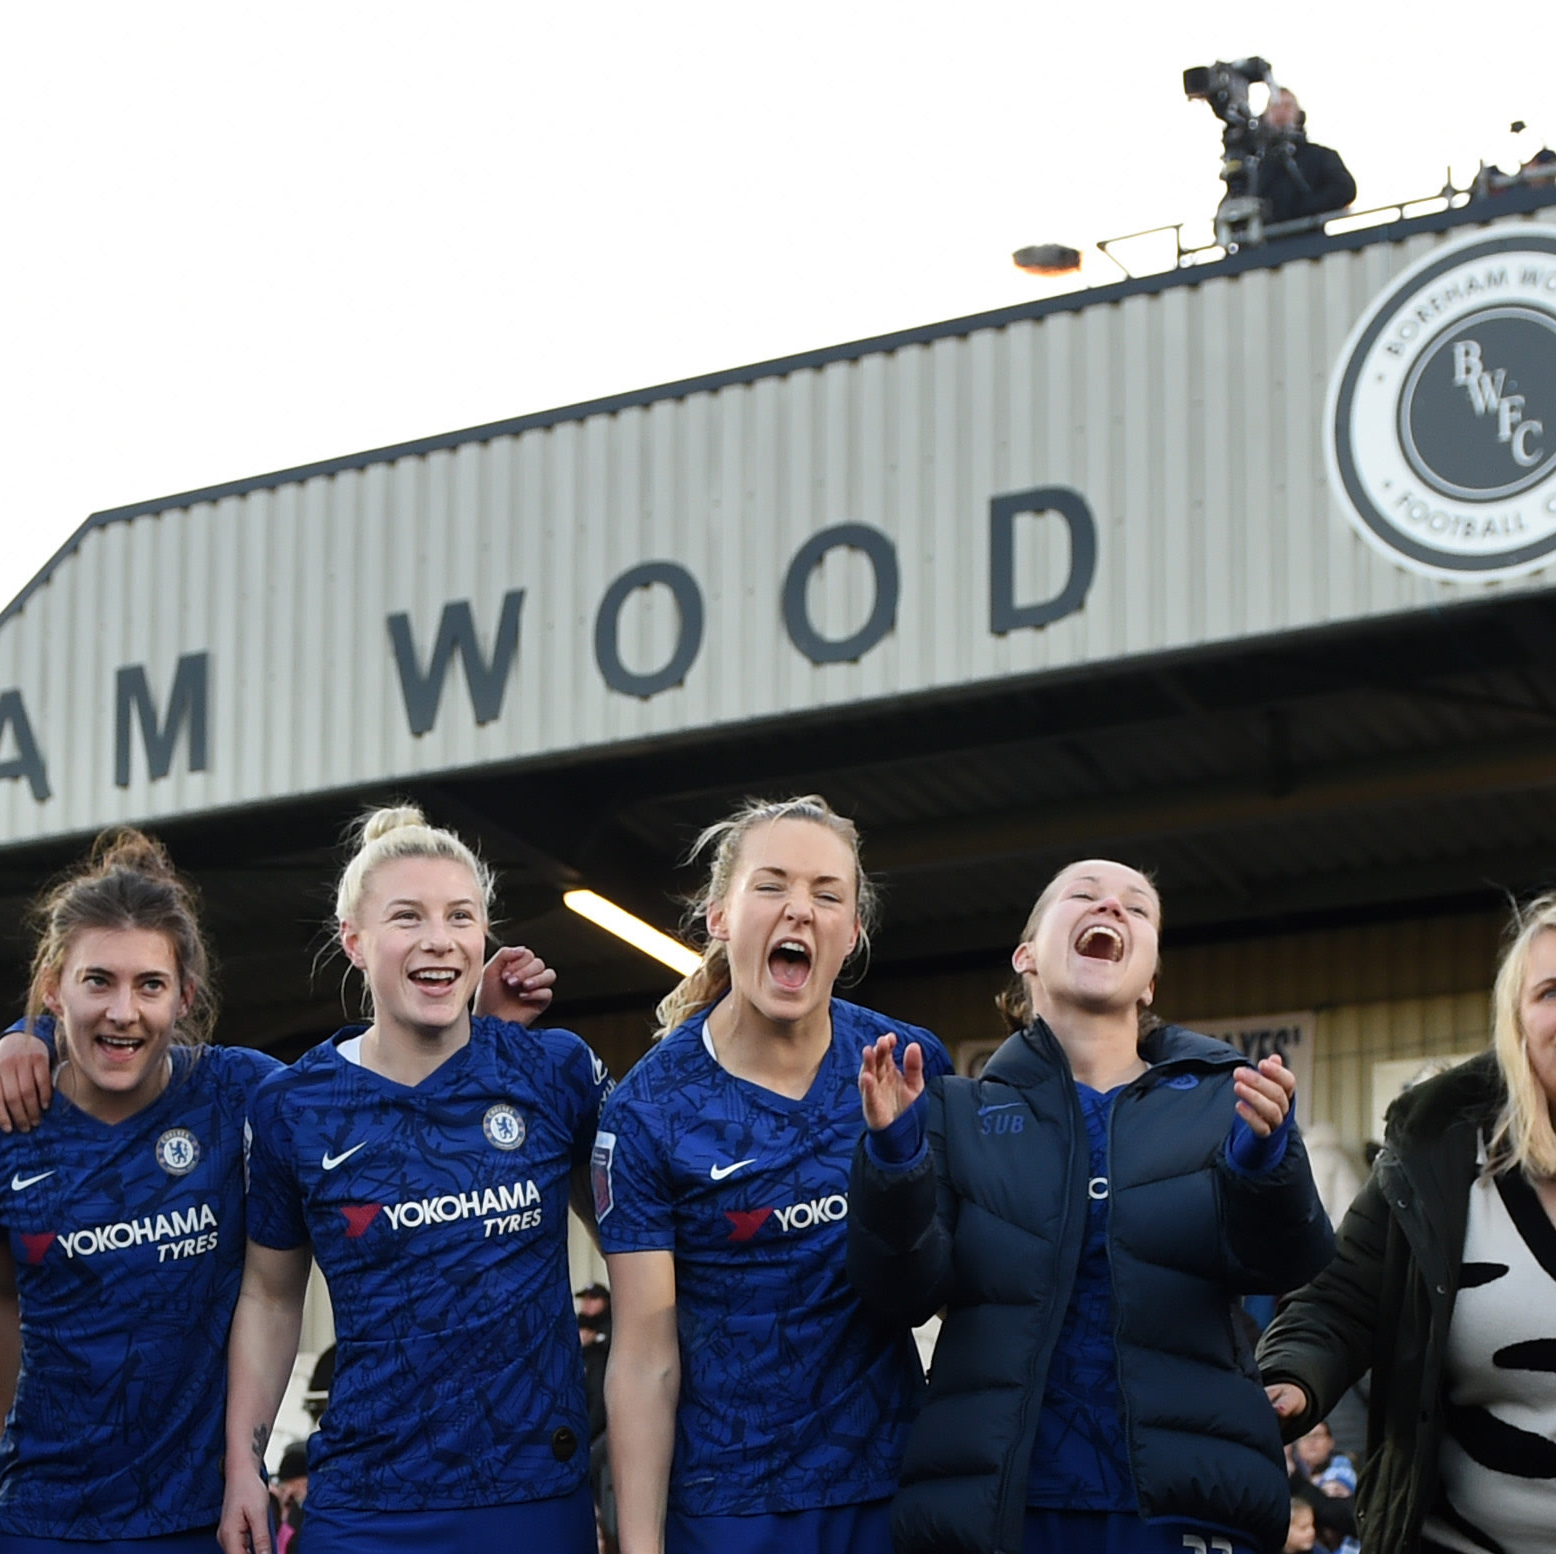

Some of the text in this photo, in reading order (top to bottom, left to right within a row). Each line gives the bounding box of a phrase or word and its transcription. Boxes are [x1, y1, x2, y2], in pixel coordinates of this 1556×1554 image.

[1396, 488, 1531, 537] FOOTBALL
[387, 485, 1097, 737] WOOD
[980, 1114, 1026, 1136] SUB
[382, 1179, 542, 1231] YOKOHAMA
[482, 1207, 543, 1239] TYRES
[773, 1190, 849, 1233] YOKO
[56, 1203, 218, 1259] YOKOHAMA
[156, 1230, 219, 1263] TYRES
